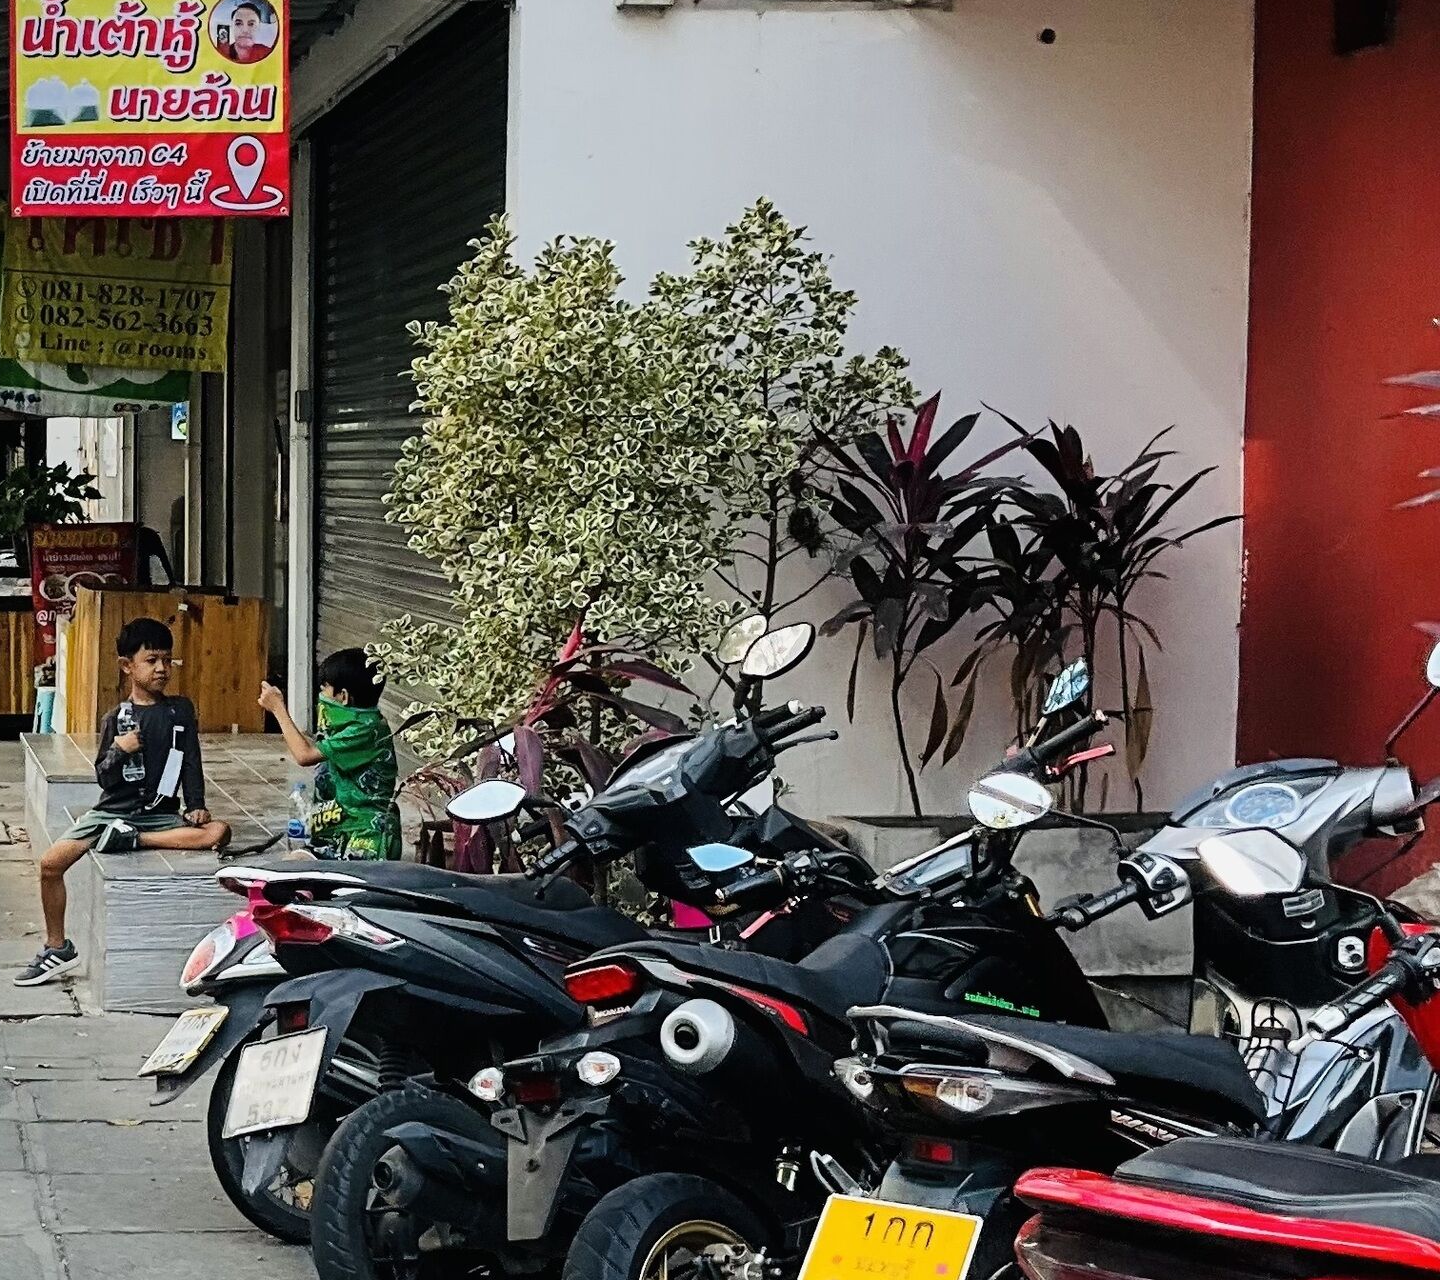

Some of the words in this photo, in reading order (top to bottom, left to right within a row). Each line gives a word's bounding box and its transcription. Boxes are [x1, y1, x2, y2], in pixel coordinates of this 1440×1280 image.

[108, 72, 276, 121] นายล้าน
[22, 139, 146, 166] ย้ายมาจาก
[150, 143, 187, 166] C4
[184, 169, 210, 204] นี้
[41, 279, 217, 312] 081-828-1707
[40, 305, 214, 337] 082-562-3663
[41, 331, 92, 351] Line
[113, 338, 208, 362] @rooms
[863, 1210, 935, 1252] 1กก
